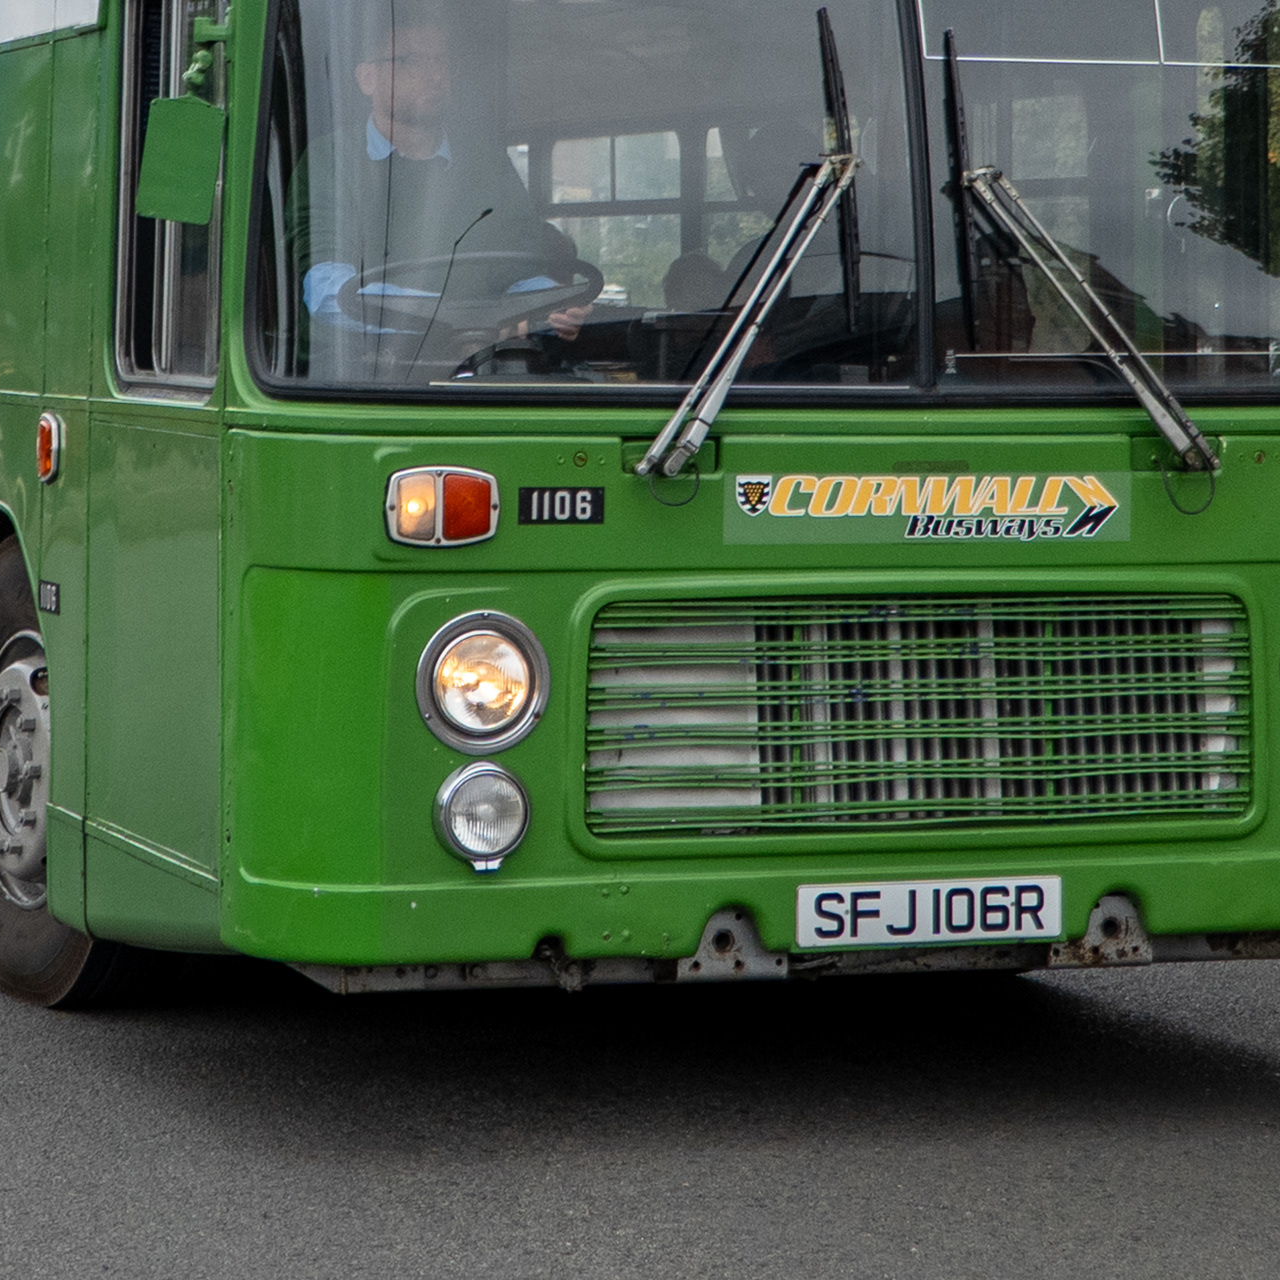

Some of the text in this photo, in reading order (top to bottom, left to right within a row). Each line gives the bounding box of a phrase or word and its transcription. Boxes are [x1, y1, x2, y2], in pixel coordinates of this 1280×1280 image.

[530, 490, 592, 521] 1106
[768, 474, 1069, 518] CORNWALL
[904, 513, 1065, 541] Busways
